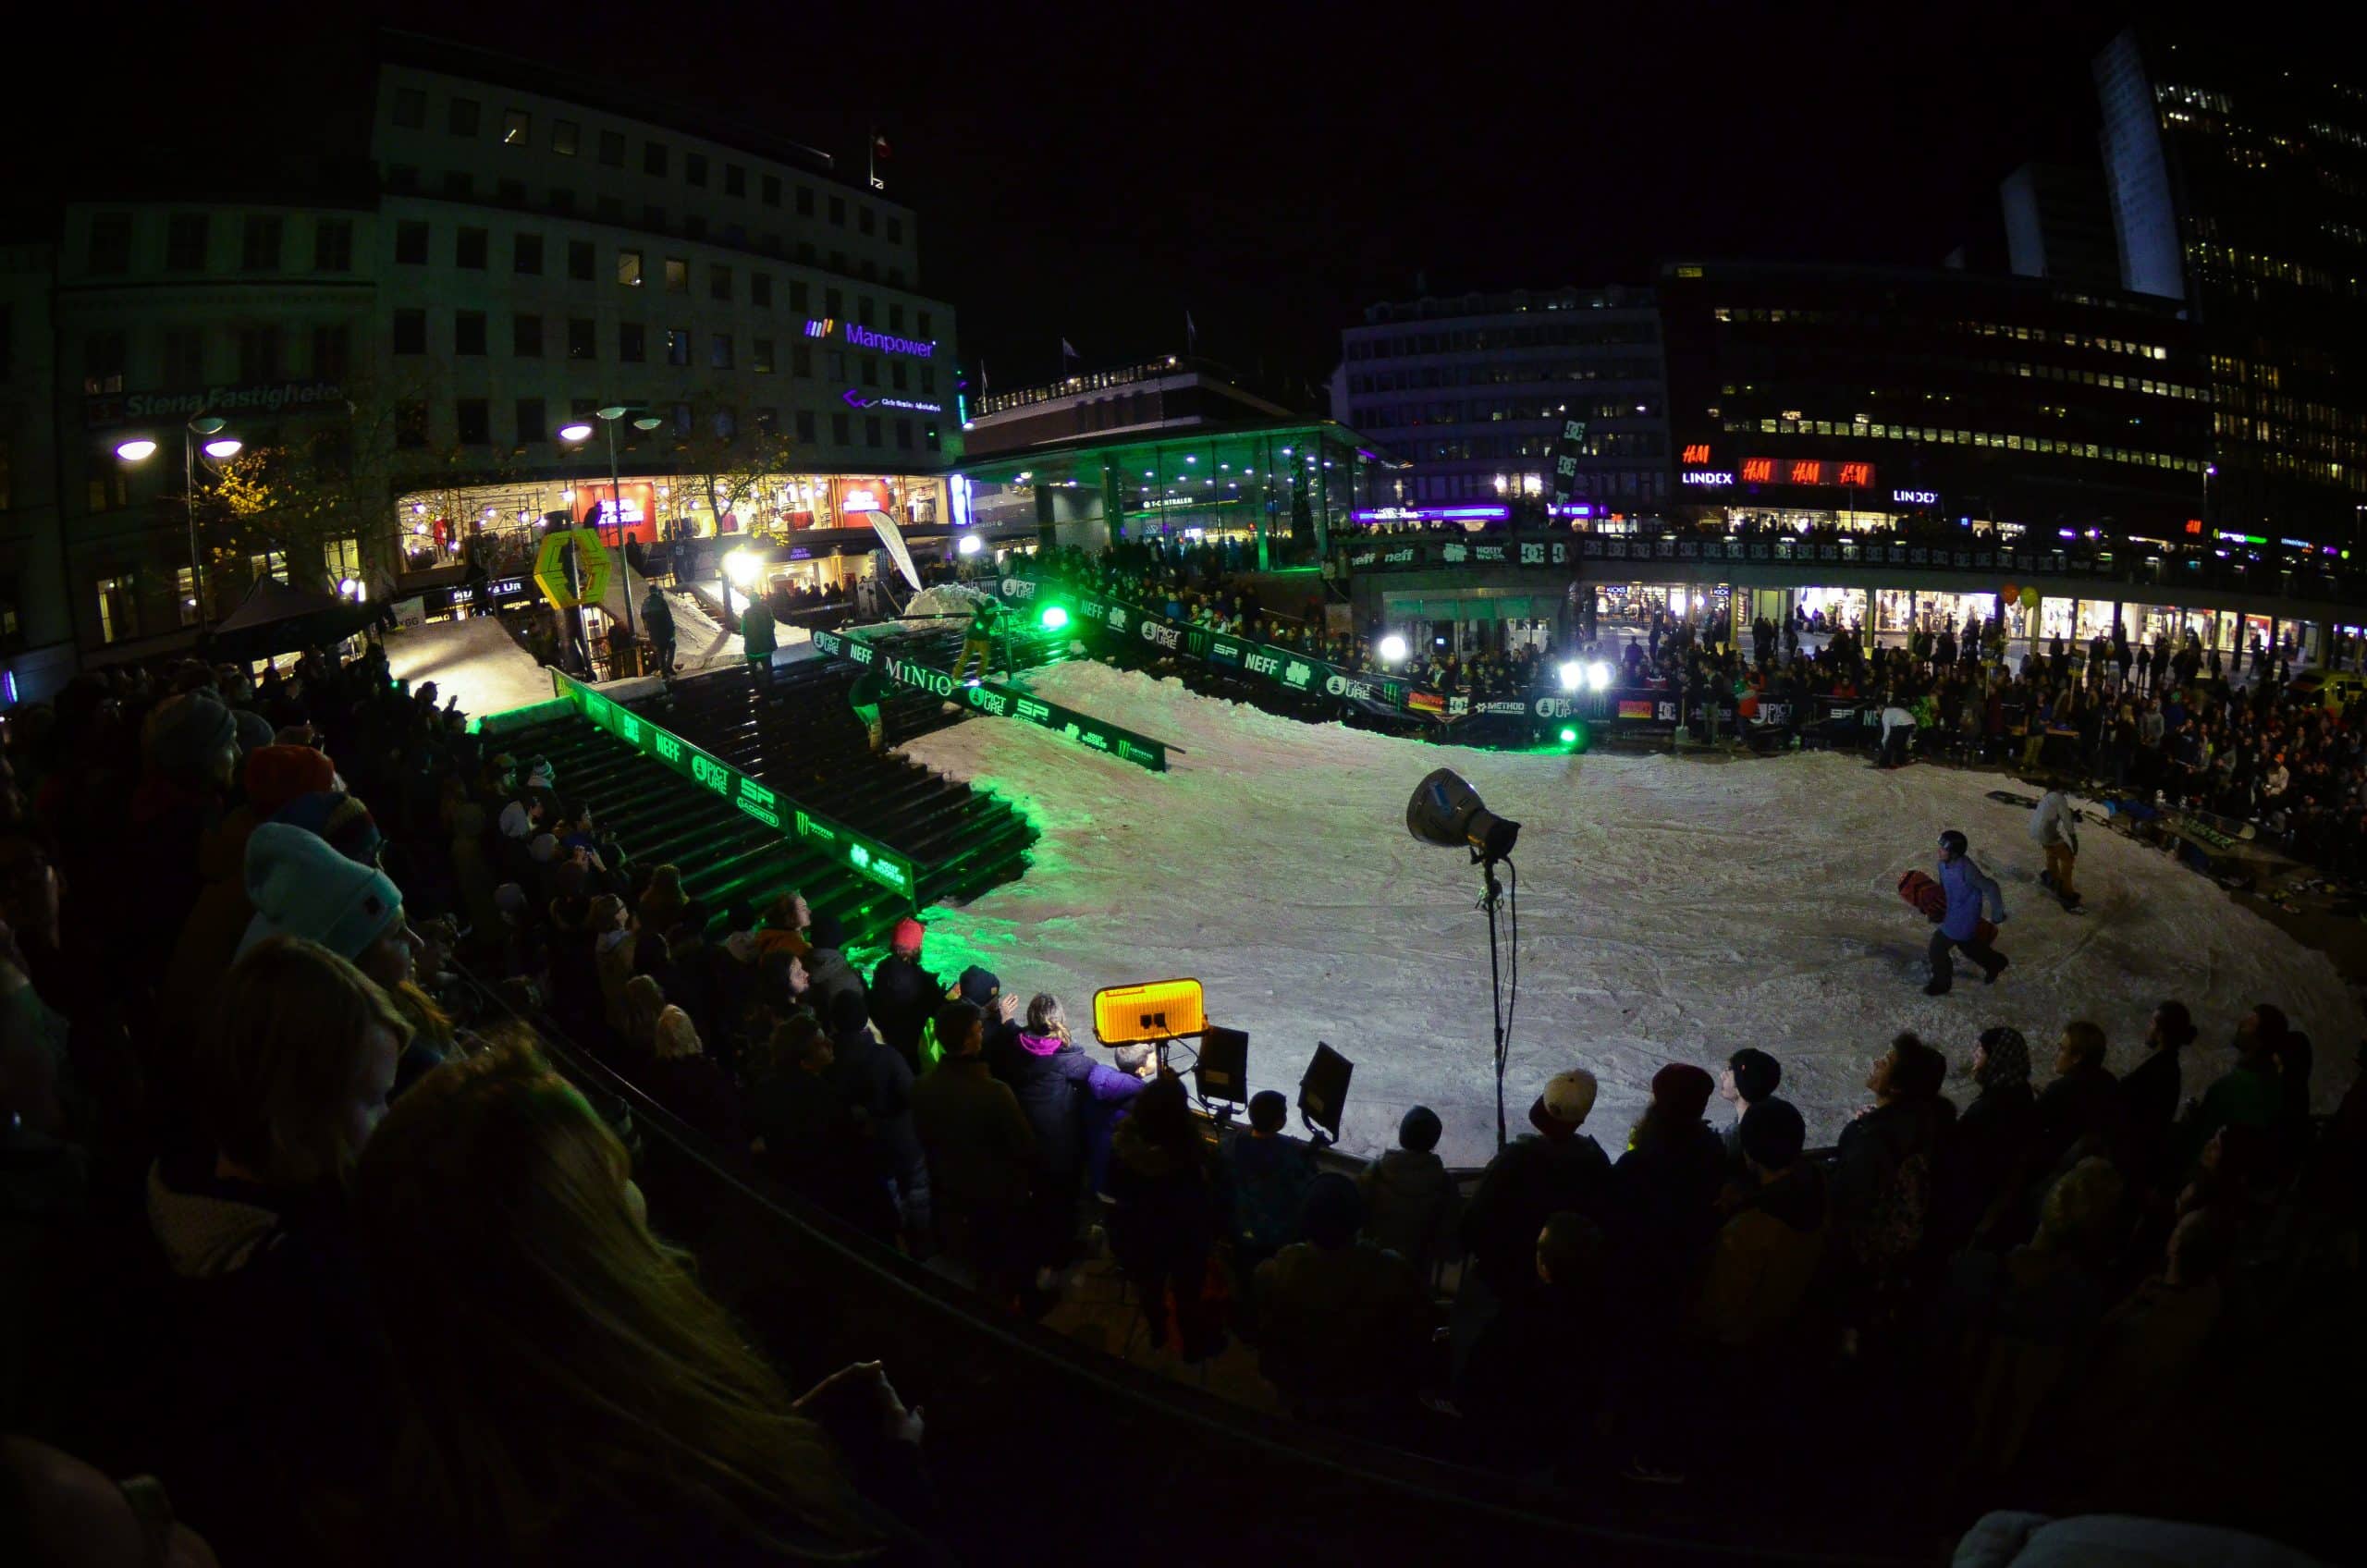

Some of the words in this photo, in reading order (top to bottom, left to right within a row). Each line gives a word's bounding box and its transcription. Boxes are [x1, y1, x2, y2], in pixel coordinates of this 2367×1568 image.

[845, 324, 933, 358] Manpower
[126, 391, 205, 416] Stena
[1683, 445, 1710, 463] H&M
[1683, 472, 1733, 484] LINDEX
[1743, 460, 1771, 481] H&M
[1793, 461, 1820, 483] H&M
[1384, 549, 1414, 562] neff
[1016, 581, 1036, 593] PICT
[1016, 588, 1035, 600] URE
[1080, 599, 1104, 619] NEFF
[1156, 623, 1182, 640] PICT
[824, 643, 839, 655] URE
[825, 634, 842, 648] PICT
[1156, 634, 1177, 650] URE
[850, 643, 873, 665] NEFF
[1245, 652, 1279, 676] NEFF
[985, 690, 1007, 706] PICT
[1345, 687, 1370, 700] URE
[984, 701, 1003, 717] URE
[1488, 702, 1525, 711] METHOD
[656, 732, 681, 762] NEFF
[707, 761, 729, 783] PICT
[707, 776, 727, 795] URE
